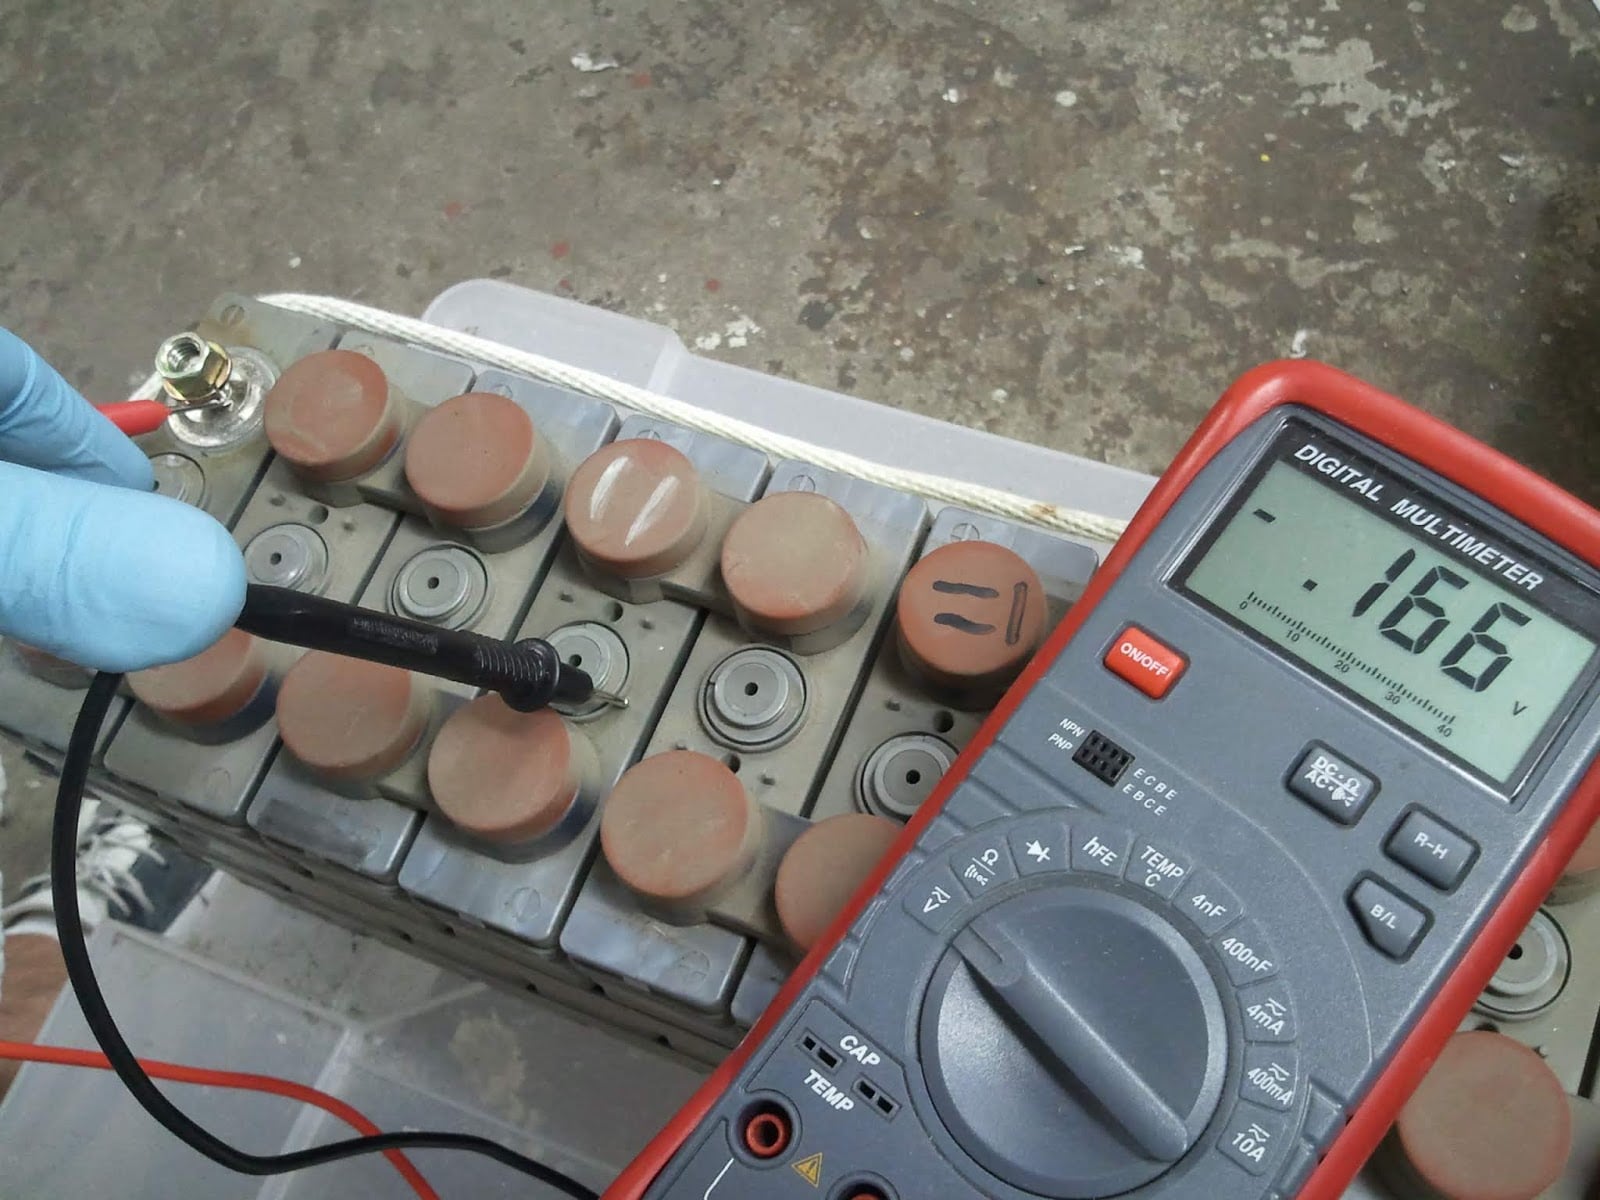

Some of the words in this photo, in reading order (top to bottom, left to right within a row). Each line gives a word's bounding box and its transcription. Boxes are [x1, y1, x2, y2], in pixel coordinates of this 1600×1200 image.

[1294, 444, 1387, 502] DIGITAL
[1389, 499, 1544, 591] MULTIMETER
[1120, 642, 1169, 678] ON/OFF
[1238, 600, 1249, 611] 0
[1285, 629, 1301, 643] 10
[1333, 660, 1351, 674] 20
[1384, 691, 1400, 705] 30
[1435, 723, 1452, 738] 40
[1048, 733, 1074, 751] PNP
[1059, 718, 1085, 737] NPN
[1082, 836, 1118, 867] hFE
[1413, 832, 1448, 860] R-H
[1140, 846, 1184, 879] TEMP
[1192, 894, 1227, 918] 4nF
[1370, 904, 1398, 929] B/L
[1221, 937, 1273, 973] 400nF
[1246, 1003, 1285, 1036] 4mA
[840, 1035, 880, 1065] CAP
[804, 1069, 854, 1110] TEMP
[1247, 1067, 1293, 1105] 400mA
[1232, 1132, 1266, 1162] 10A
